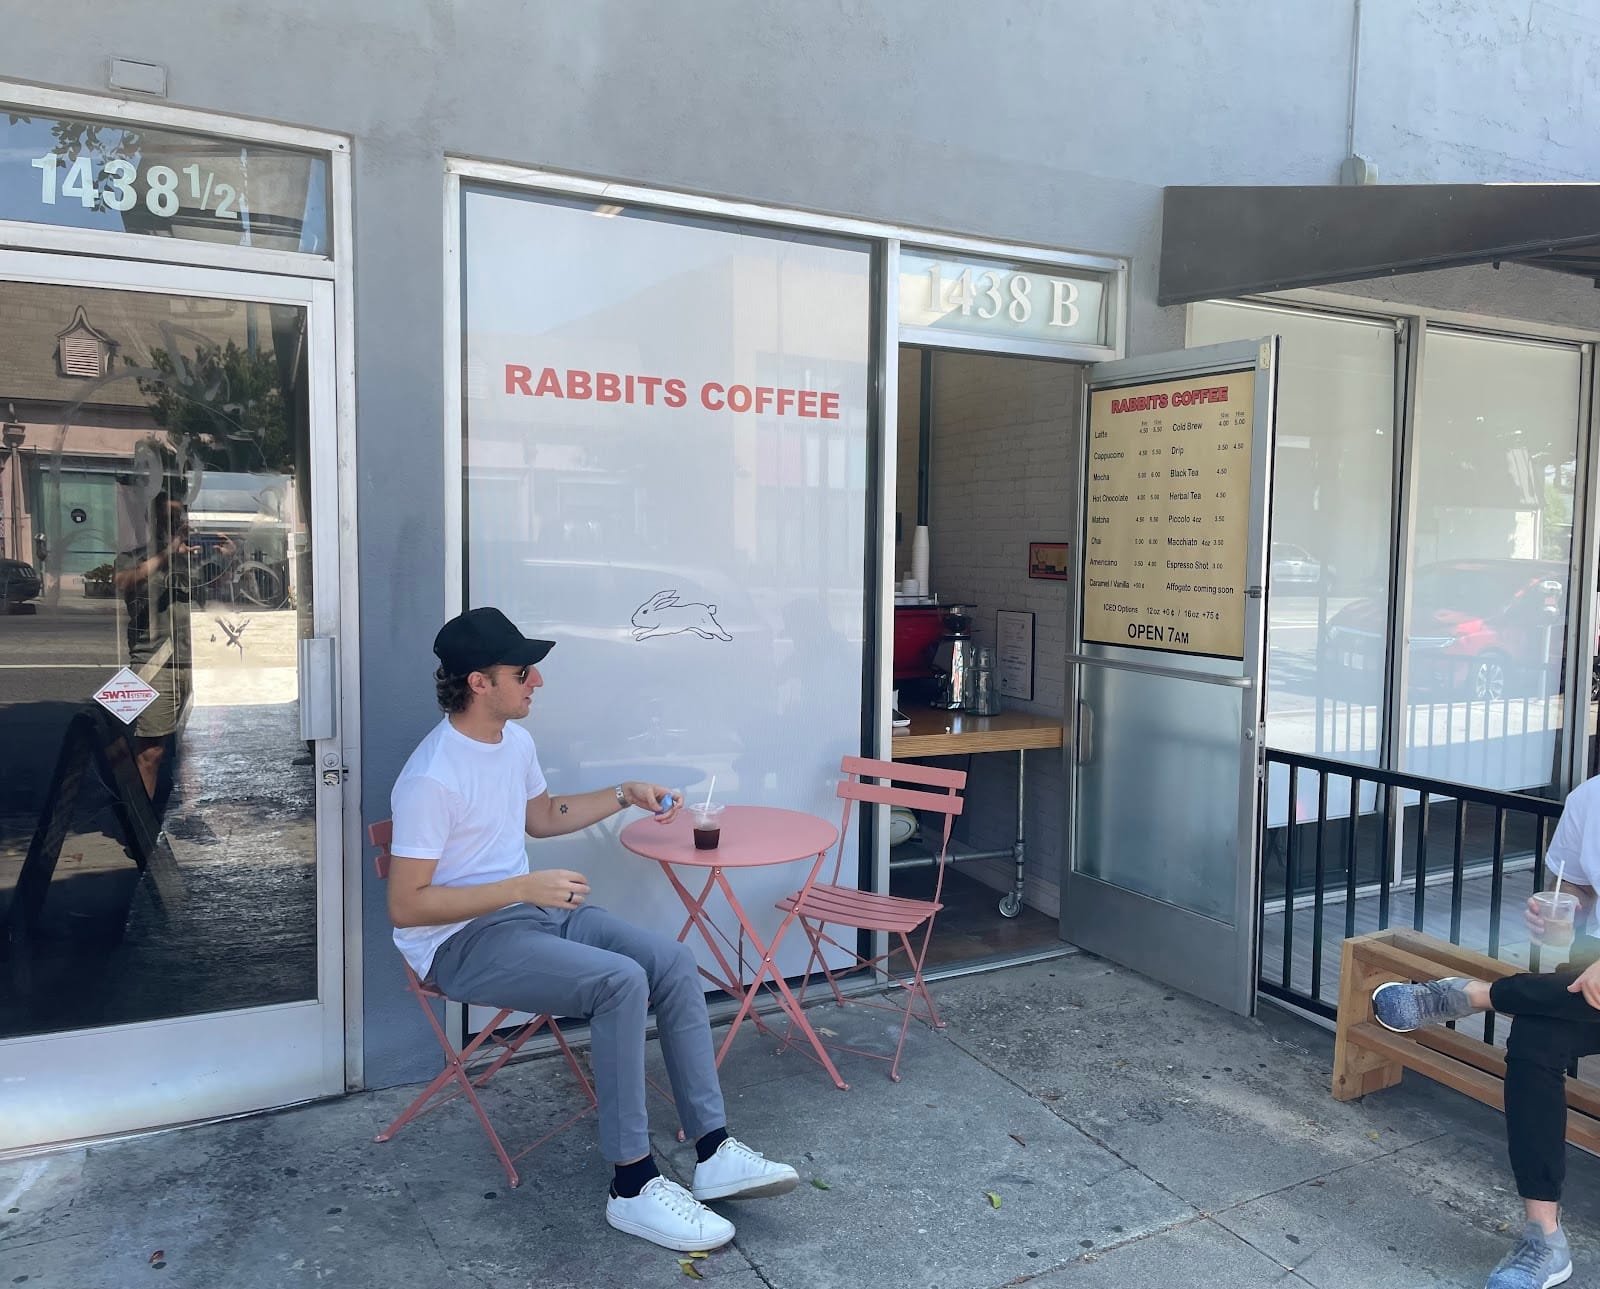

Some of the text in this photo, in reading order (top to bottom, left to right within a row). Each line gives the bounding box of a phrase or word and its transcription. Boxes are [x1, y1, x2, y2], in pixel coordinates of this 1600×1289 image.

[928, 263, 1080, 327] 1438 B
[505, 364, 840, 419] RABBITS COFFEE
[1111, 386, 1229, 414] RABBITS COFFEE
[1172, 423, 1186, 432] Cold
[1187, 422, 1202, 431] Brew
[1094, 431, 1108, 439] Latte
[1093, 451, 1124, 461] Cappuccino
[1171, 446, 1184, 456] Drip
[1093, 473, 1110, 481] Mocha
[1170, 469, 1187, 478] Black
[1187, 468, 1199, 477] Tea
[1102, 494, 1128, 502] Chocolate
[1169, 492, 1189, 500] Herbal
[1190, 491, 1202, 500] Tea
[1091, 515, 1110, 524] Matcha
[1168, 515, 1191, 524] Piccolo
[1167, 537, 1198, 546] Macchiato
[1201, 539, 1211, 547] 4oz
[1089, 557, 1118, 567] Americano
[1166, 560, 1194, 571] Espresso
[1194, 560, 1209, 570] Shot
[1089, 578, 1110, 588] Caramel
[1113, 579, 1130, 589] Vanilla
[1166, 582, 1234, 595] Affogato coming soon
[1103, 603, 1117, 612] ICED
[1117, 604, 1139, 614] Options
[1128, 623, 1189, 645] OPEN 7AM
